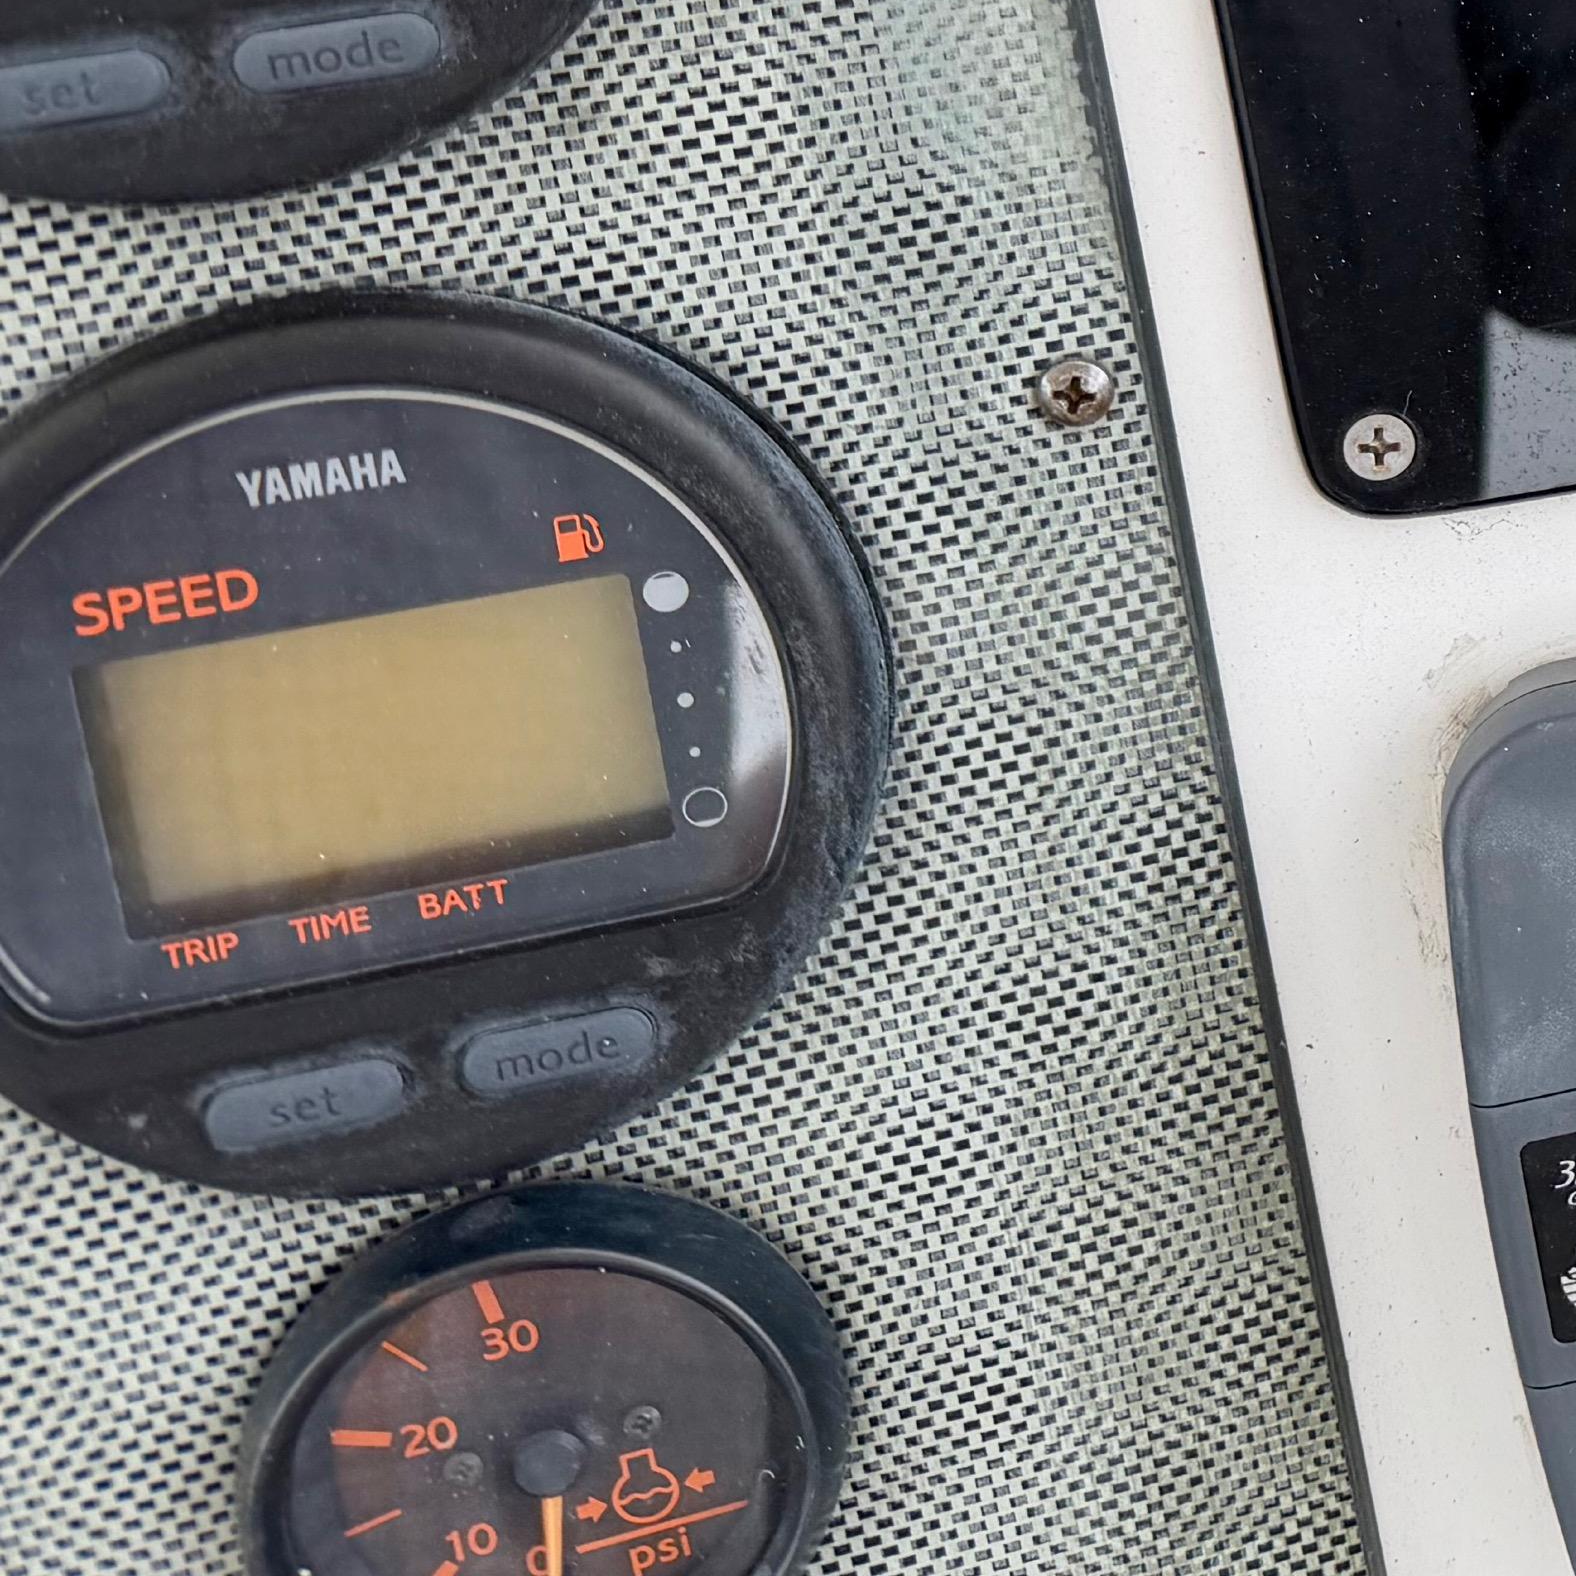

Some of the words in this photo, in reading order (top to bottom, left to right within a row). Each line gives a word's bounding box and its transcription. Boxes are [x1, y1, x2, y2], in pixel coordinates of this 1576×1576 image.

[266, 30, 406, 81] mode
[20, 71, 100, 118] set
[235, 448, 407, 508] YAMAHA
[71, 568, 259, 636] SPEED
[161, 931, 240, 970] TRIP
[289, 906, 373, 945] TIME
[417, 879, 508, 920] BATT
[496, 1033, 620, 1081] mode
[268, 1086, 342, 1127] set
[480, 1319, 539, 1362] 30
[403, 1416, 458, 1459] 20
[445, 1522, 498, 1562] 10
[628, 1526, 692, 1576] psi
